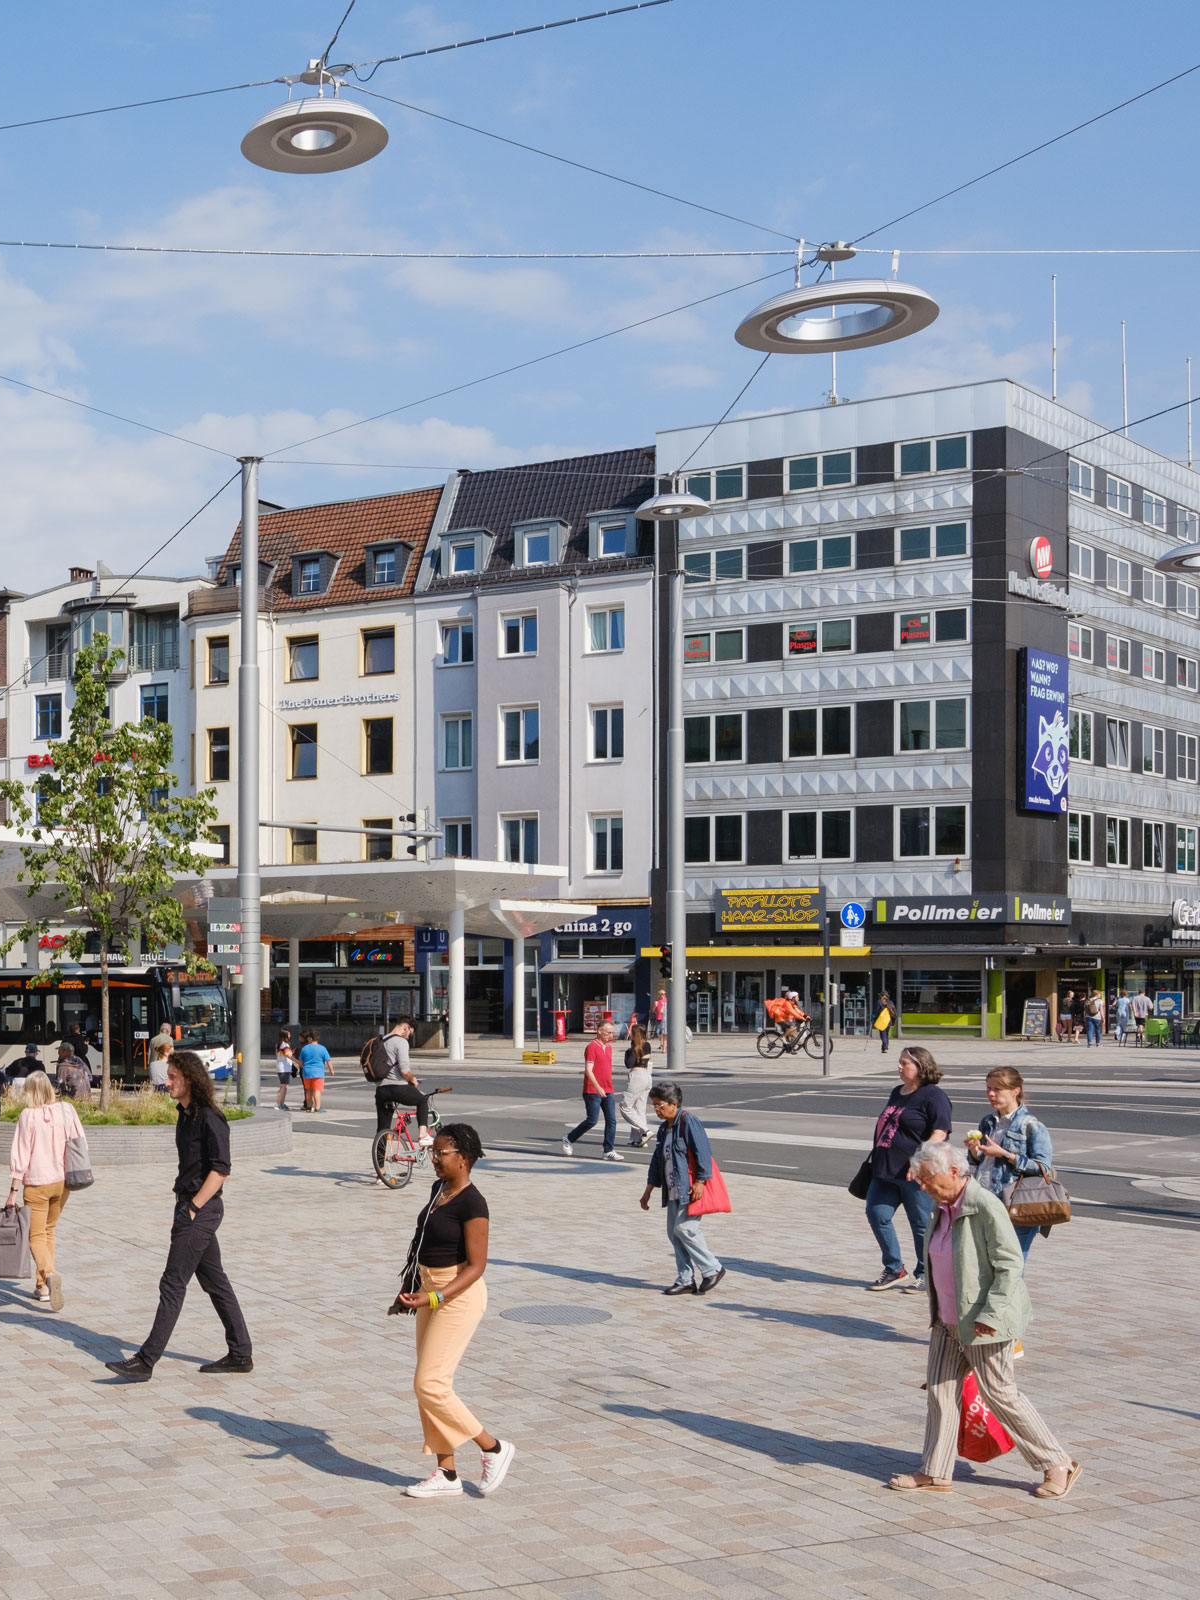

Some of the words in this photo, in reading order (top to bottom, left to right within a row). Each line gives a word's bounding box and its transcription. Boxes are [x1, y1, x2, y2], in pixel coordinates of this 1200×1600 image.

[906, 619, 923, 628] CSL
[795, 630, 810, 639] CSL
[901, 631, 929, 640] Plasma
[789, 641, 817, 649] Plasma
[684, 650, 710, 659] Plasma
[1030, 670, 1052, 687] WANN?
[1030, 684, 1046, 699] FRAG
[303, 697, 341, 707] Döner
[343, 692, 400, 705] Brothers
[727, 895, 812, 909] PAPILLOTE
[721, 909, 820, 923] HAAR-SHOP
[893, 901, 1003, 921] Pollmeier
[1021, 902, 1065, 921] Pollmeier
[601, 919, 611, 932] 2
[613, 921, 633, 936] go
[350, 948, 366, 961] Ice
